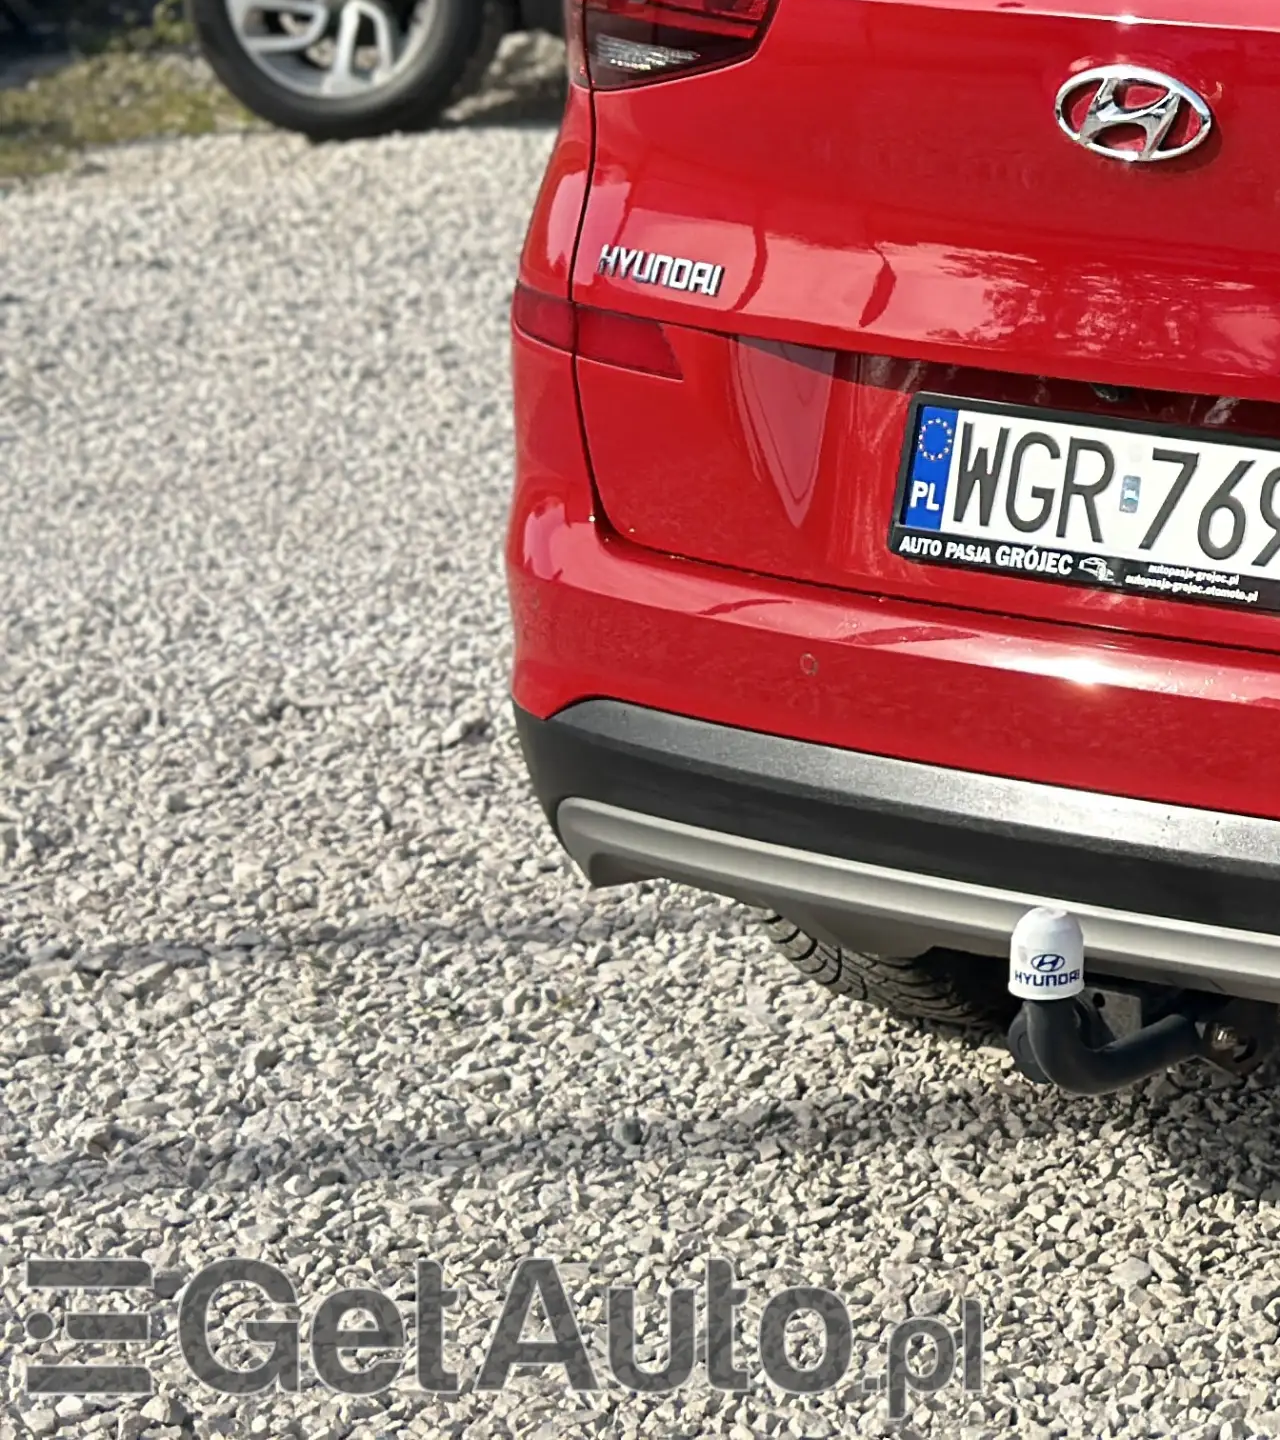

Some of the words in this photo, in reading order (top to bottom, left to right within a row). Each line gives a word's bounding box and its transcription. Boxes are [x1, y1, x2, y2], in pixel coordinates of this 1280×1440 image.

[598, 243, 725, 297] HYUNDAI
[910, 480, 940, 512] PL
[952, 421, 1116, 543] WGR
[899, 535, 942, 557] AUTO
[944, 541, 991, 563] PASJA
[995, 544, 1073, 576] GRÓJEC
[1014, 968, 1081, 987] HYUNDAI
